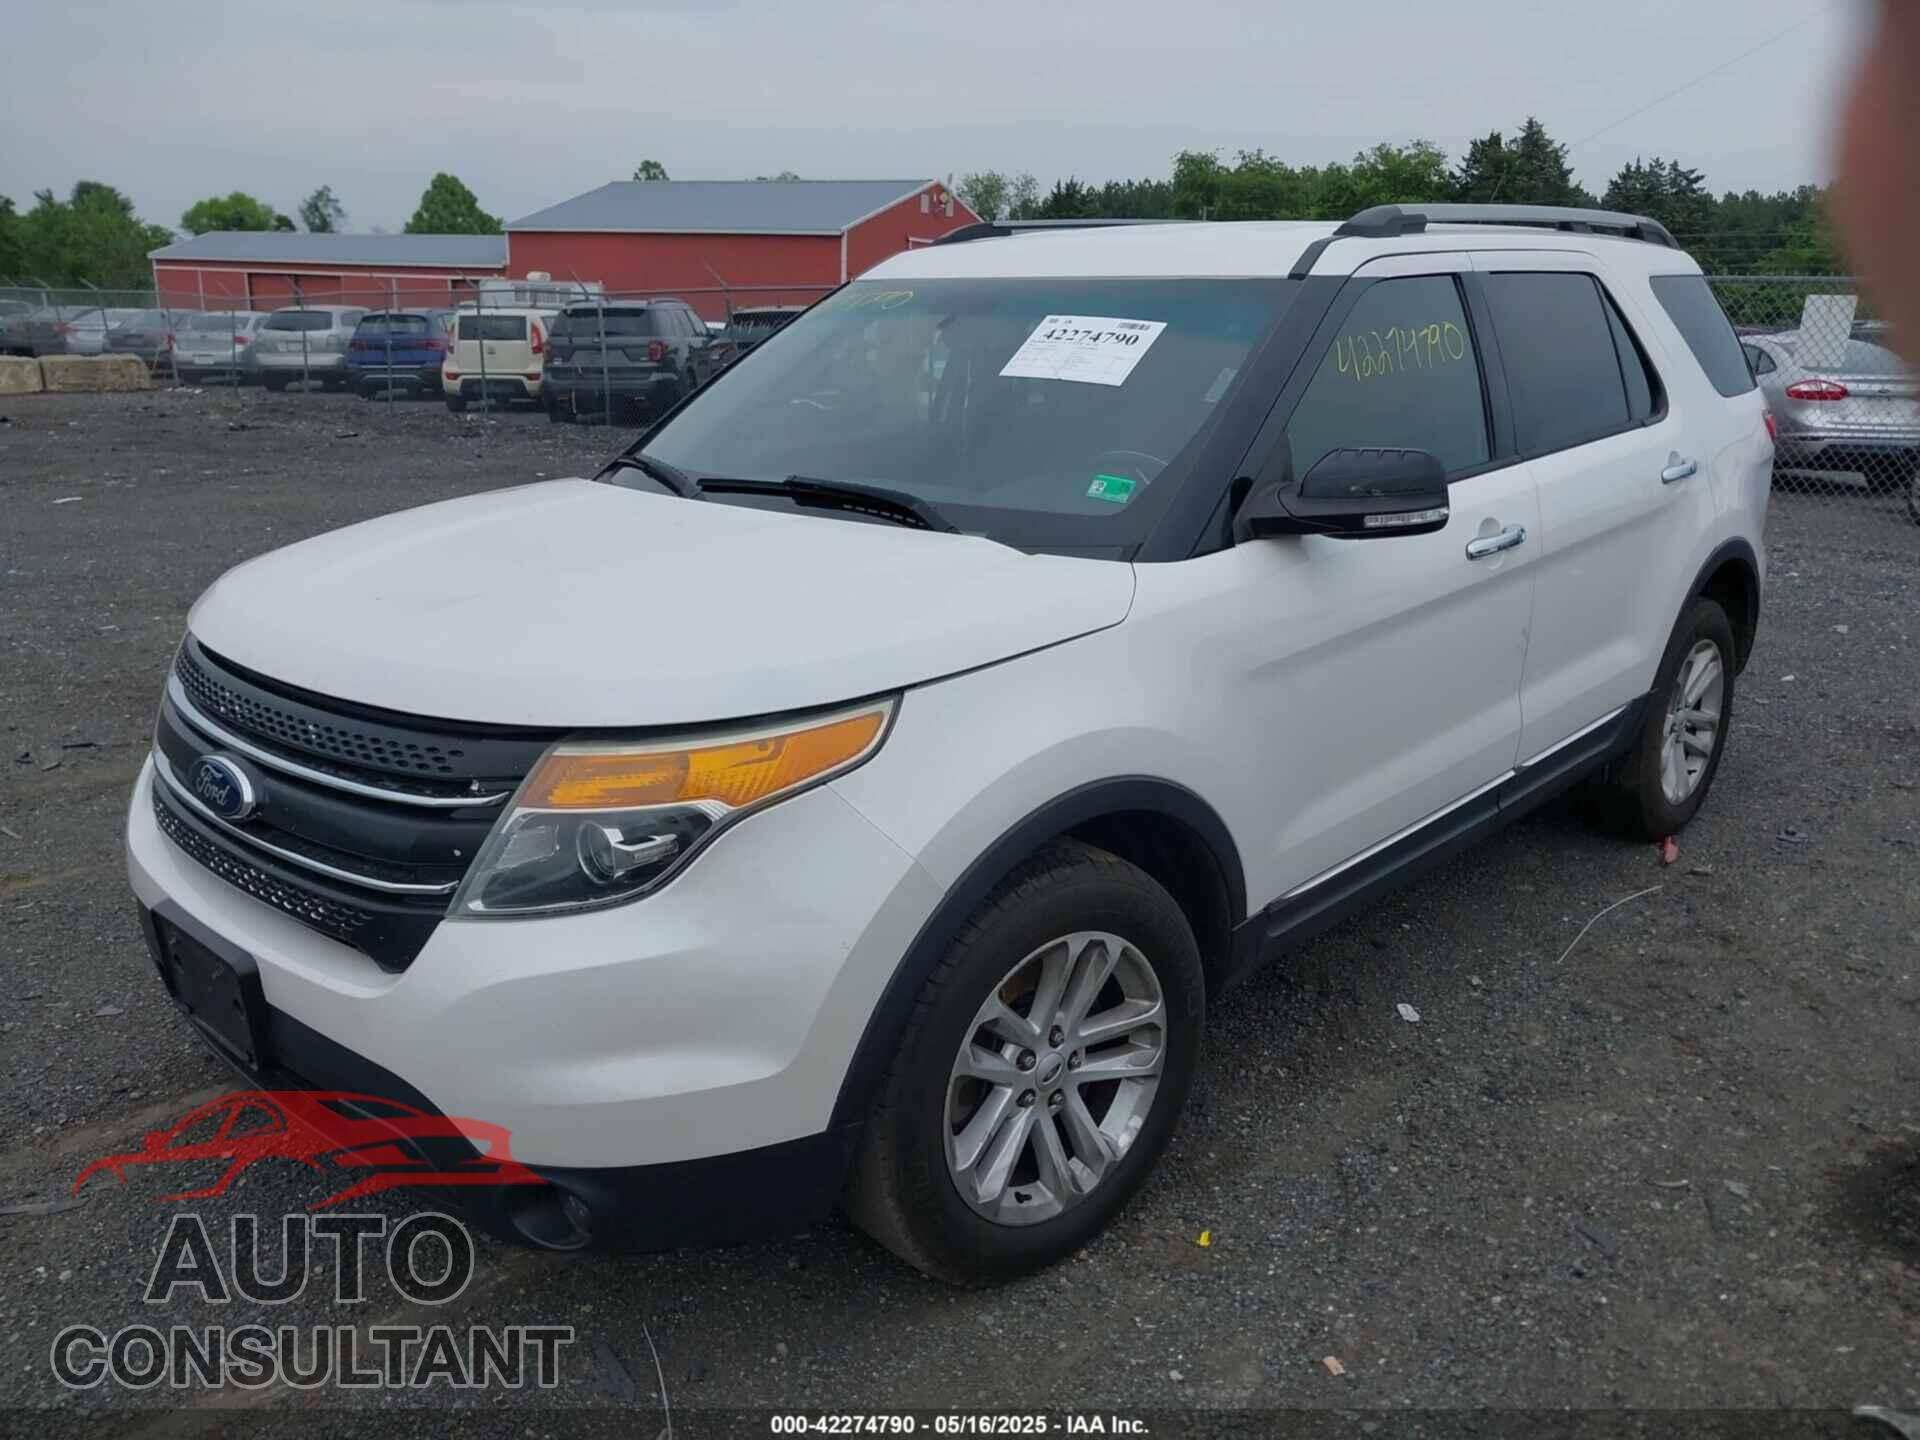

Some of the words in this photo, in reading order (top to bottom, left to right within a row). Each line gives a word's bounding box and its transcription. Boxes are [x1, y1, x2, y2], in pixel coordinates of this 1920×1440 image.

[1042, 328, 1140, 346] 42274790
[1336, 321, 1464, 381] 42274790
[196, 764, 231, 806] Ford
